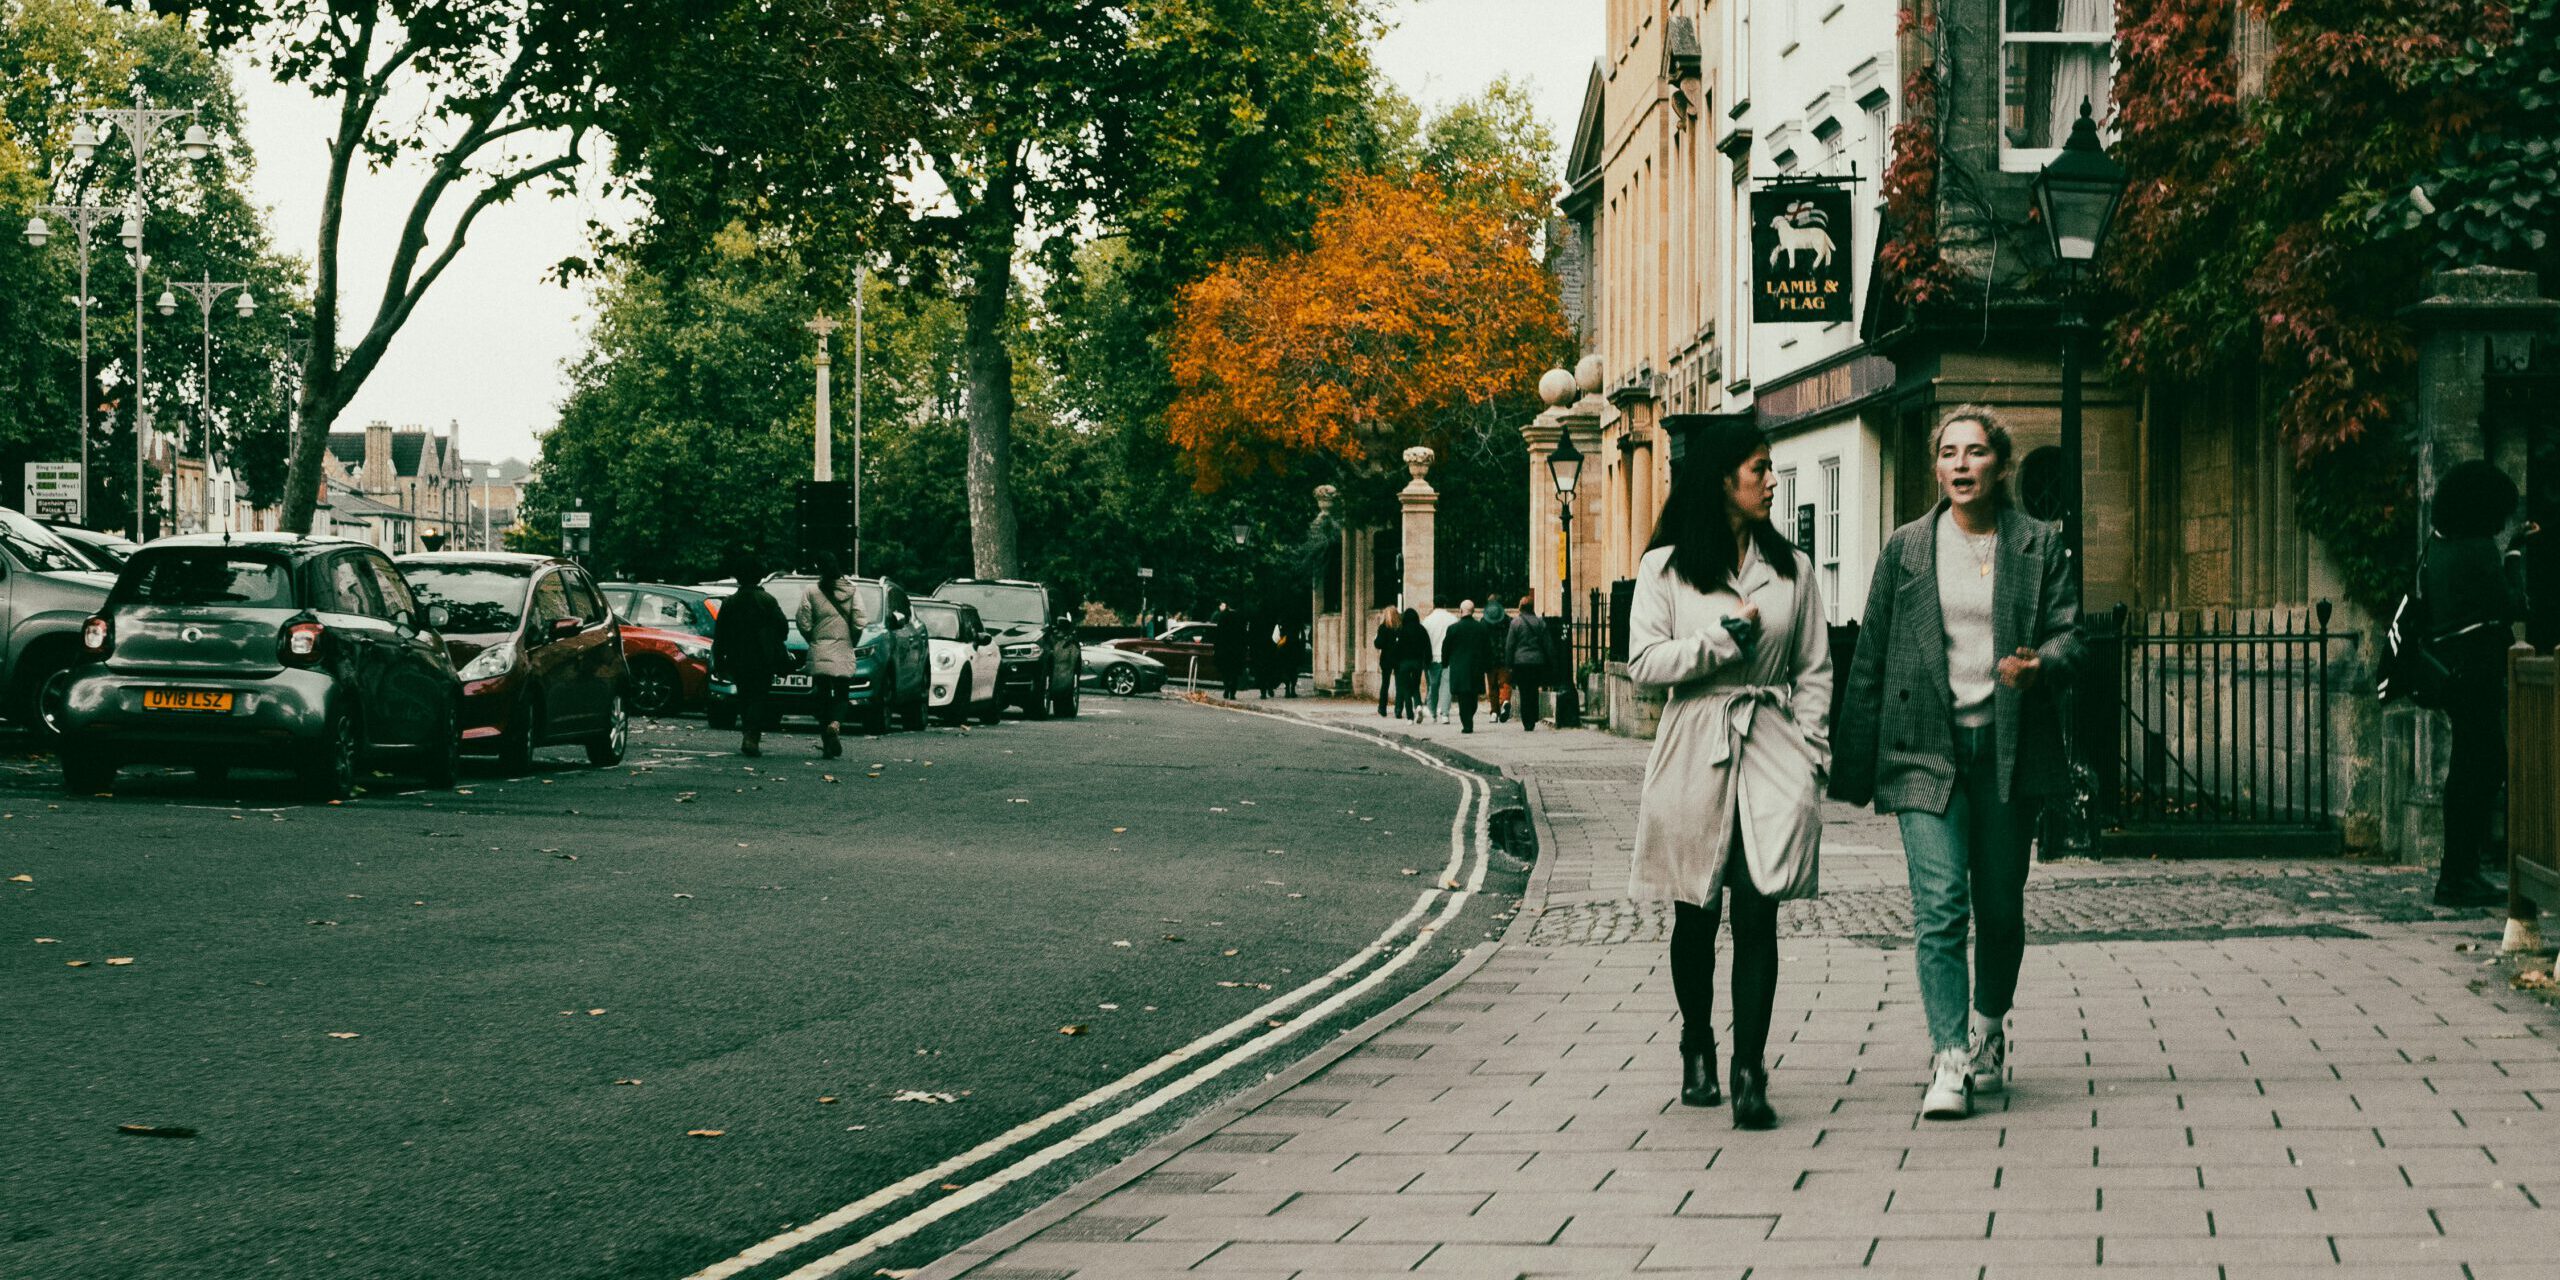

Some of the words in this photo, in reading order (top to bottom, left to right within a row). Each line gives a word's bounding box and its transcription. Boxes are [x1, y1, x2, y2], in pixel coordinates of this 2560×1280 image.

[1766, 280, 1818, 294] LAMB
[1824, 280, 1839, 293] &
[1780, 296, 1826, 310] FLAG
[192, 692, 223, 707] LSZ
